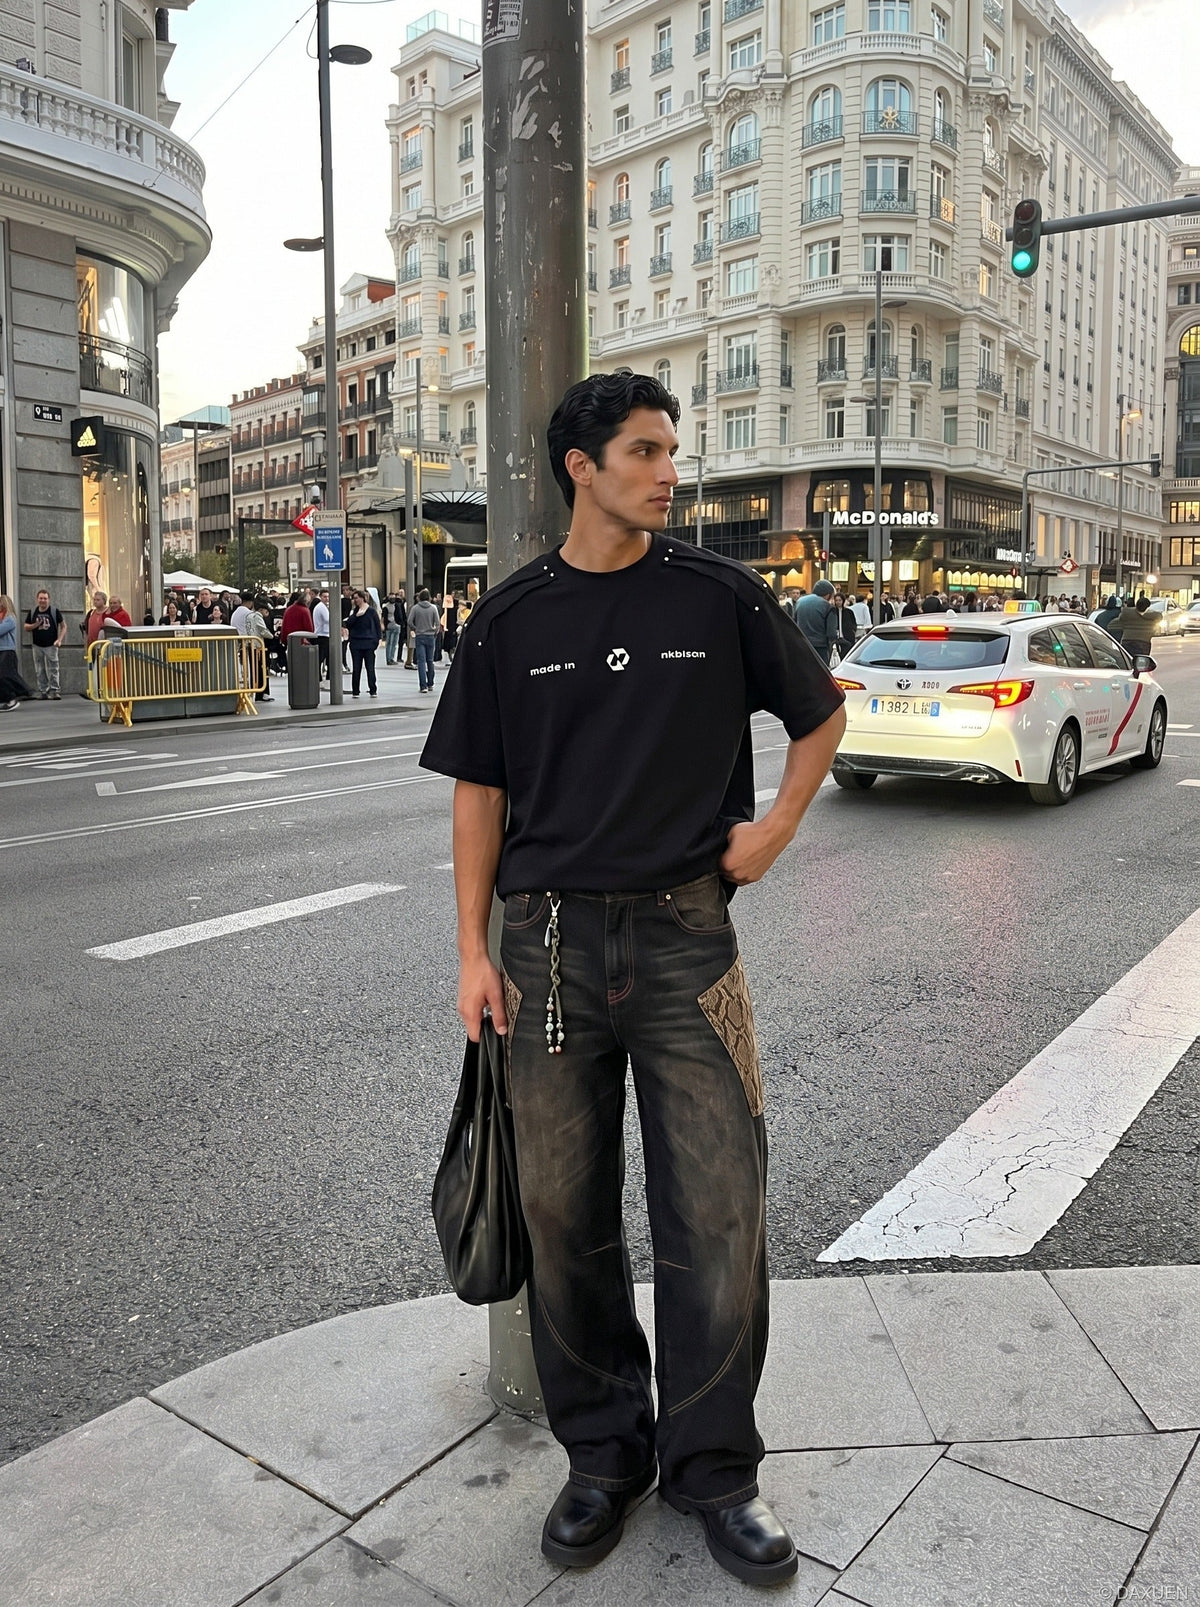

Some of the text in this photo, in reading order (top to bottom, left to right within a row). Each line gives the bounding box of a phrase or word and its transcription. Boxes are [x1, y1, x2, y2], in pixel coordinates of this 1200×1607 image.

[832, 511, 939, 525] McDonald's
[530, 662, 576, 676] made in
[880, 700, 909, 713] 1382
